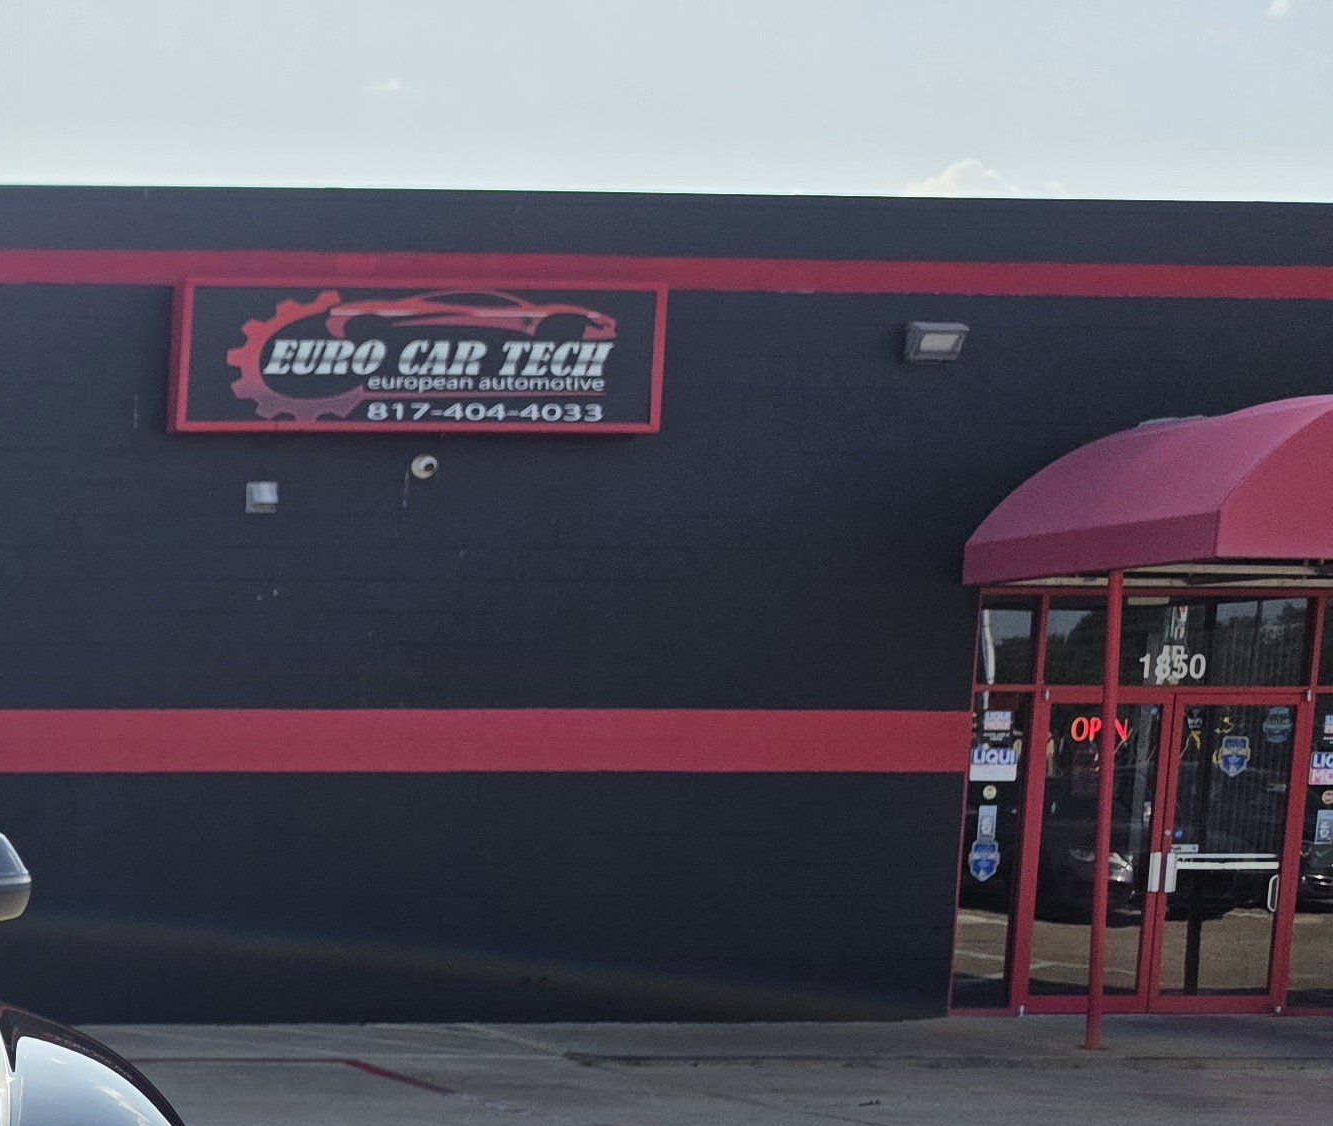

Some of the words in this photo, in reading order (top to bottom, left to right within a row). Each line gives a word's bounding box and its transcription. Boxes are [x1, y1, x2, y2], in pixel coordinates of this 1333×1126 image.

[263, 338, 387, 376] EURO
[398, 339, 489, 376] CAR
[498, 341, 615, 377] TECH
[367, 375, 474, 393] european
[478, 376, 606, 392] automotive
[366, 401, 604, 422] 817-404-4033
[1139, 652, 1207, 680] 1850
[1070, 716, 1129, 742] OPN
